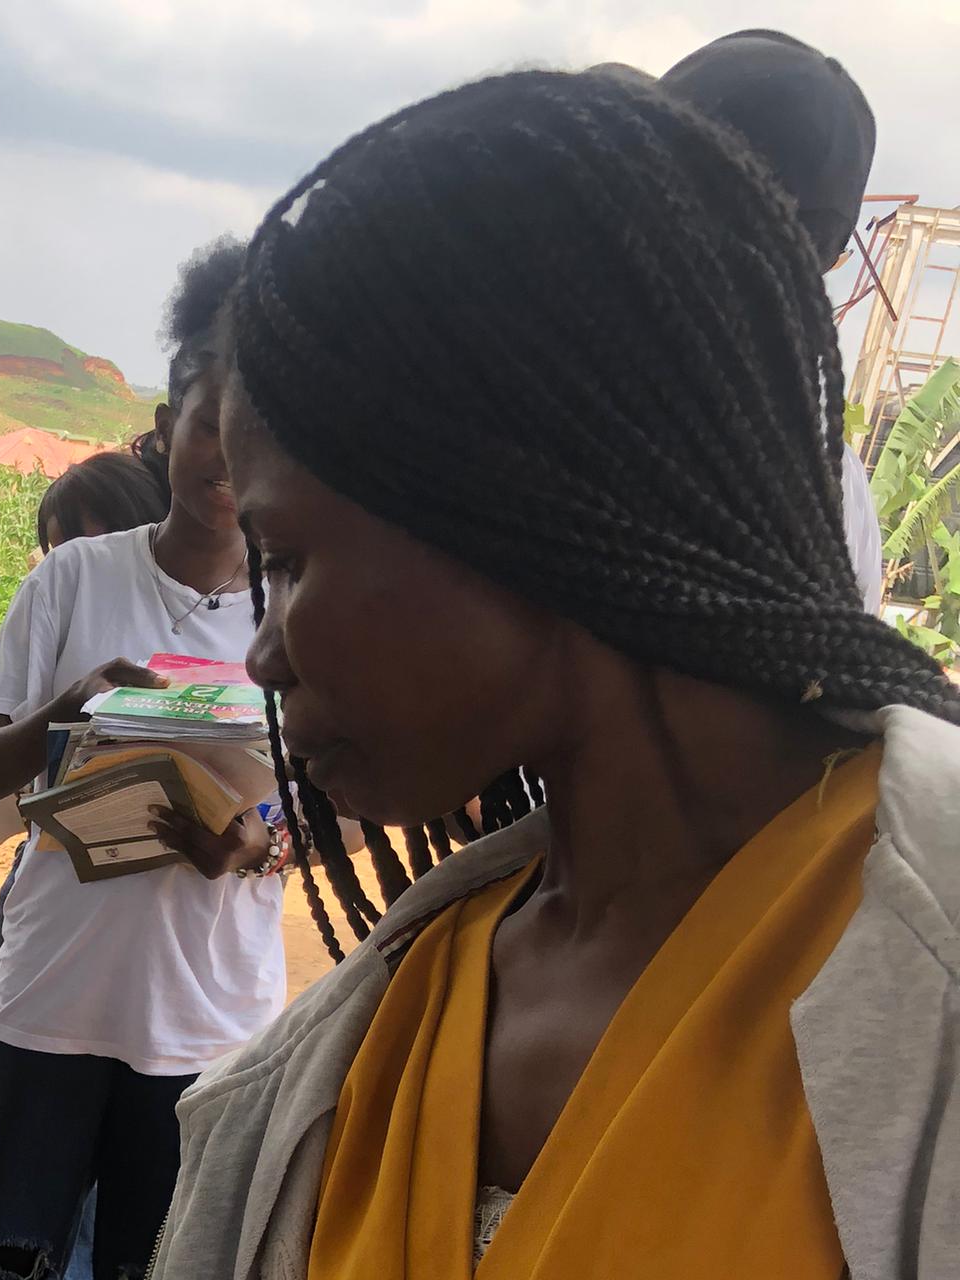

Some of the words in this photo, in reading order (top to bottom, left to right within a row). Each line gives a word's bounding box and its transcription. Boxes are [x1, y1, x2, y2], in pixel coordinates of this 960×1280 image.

[191, 686, 220, 698] 2
[121, 702, 207, 714] PRIMARY
[122, 697, 259, 714] MATHEMATICS
